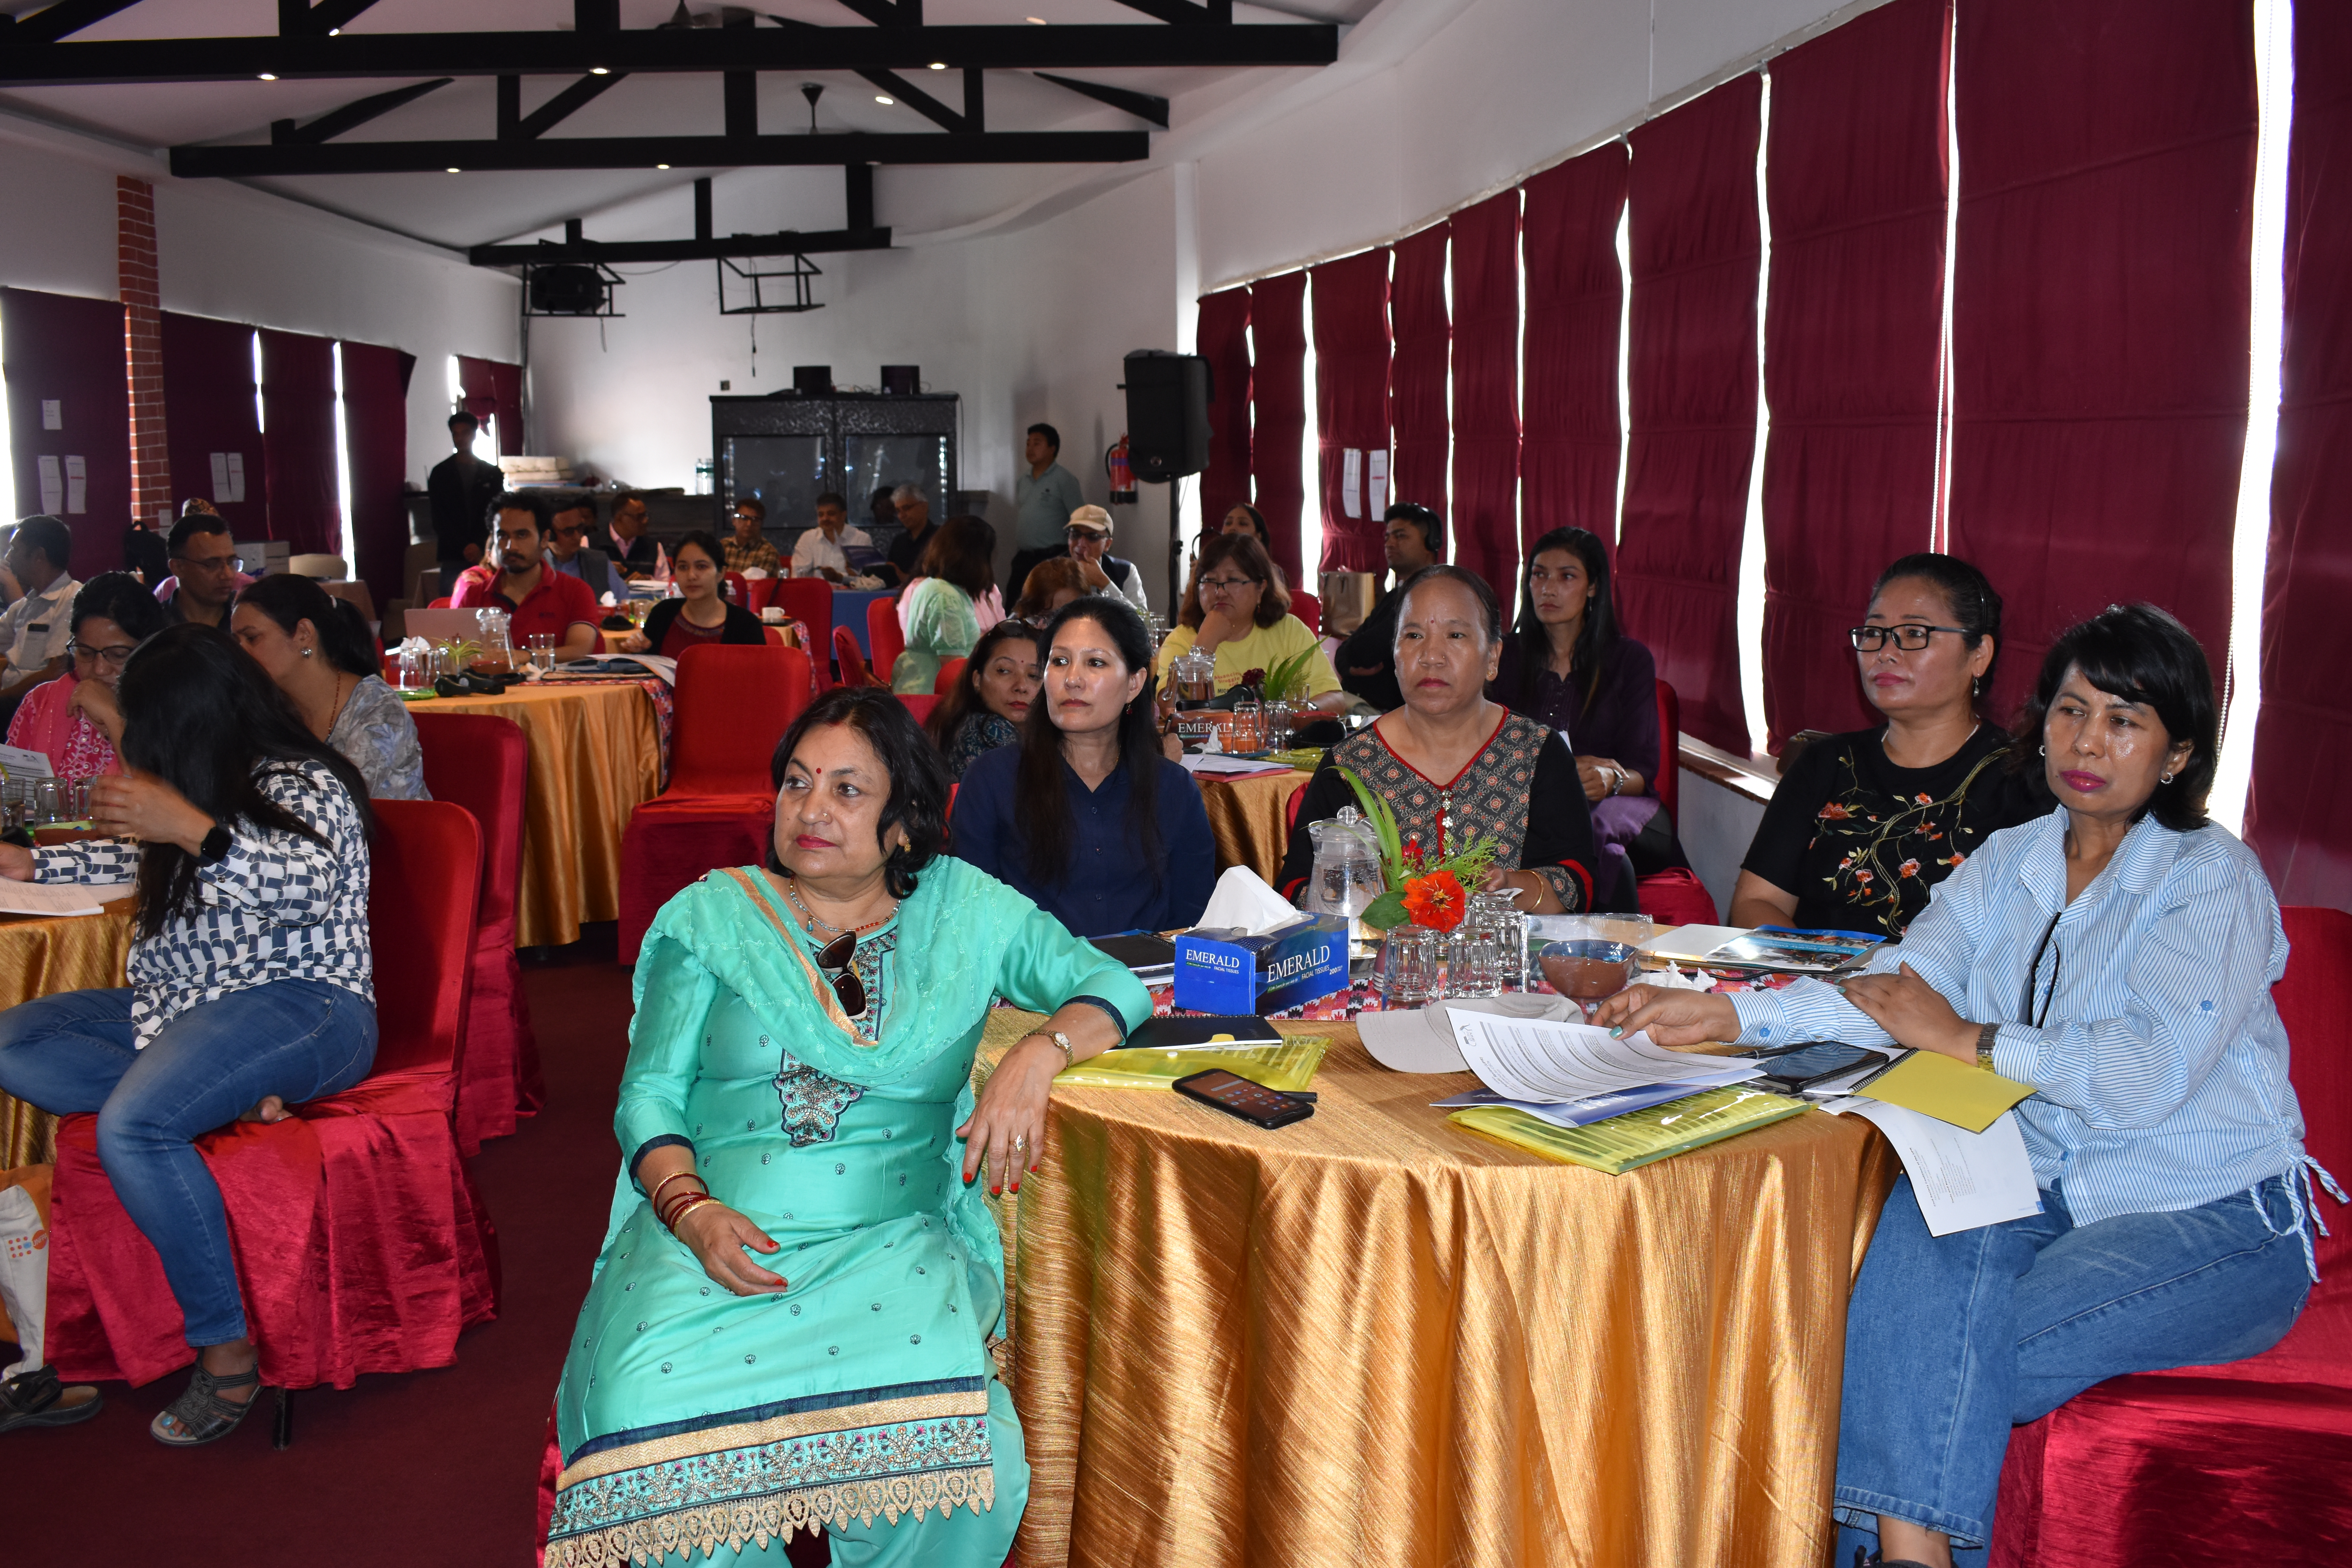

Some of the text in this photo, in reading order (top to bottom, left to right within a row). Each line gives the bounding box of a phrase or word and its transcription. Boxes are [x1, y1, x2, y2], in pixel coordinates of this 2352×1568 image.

[1178, 723, 1233, 733] EMERAL
[1186, 949, 1239, 967] EMERALD
[1267, 946, 1330, 983] EMERALD
[1301, 964, 1330, 980] FACIAL TISSUES
[33, 1233, 47, 1246] UNFPA
